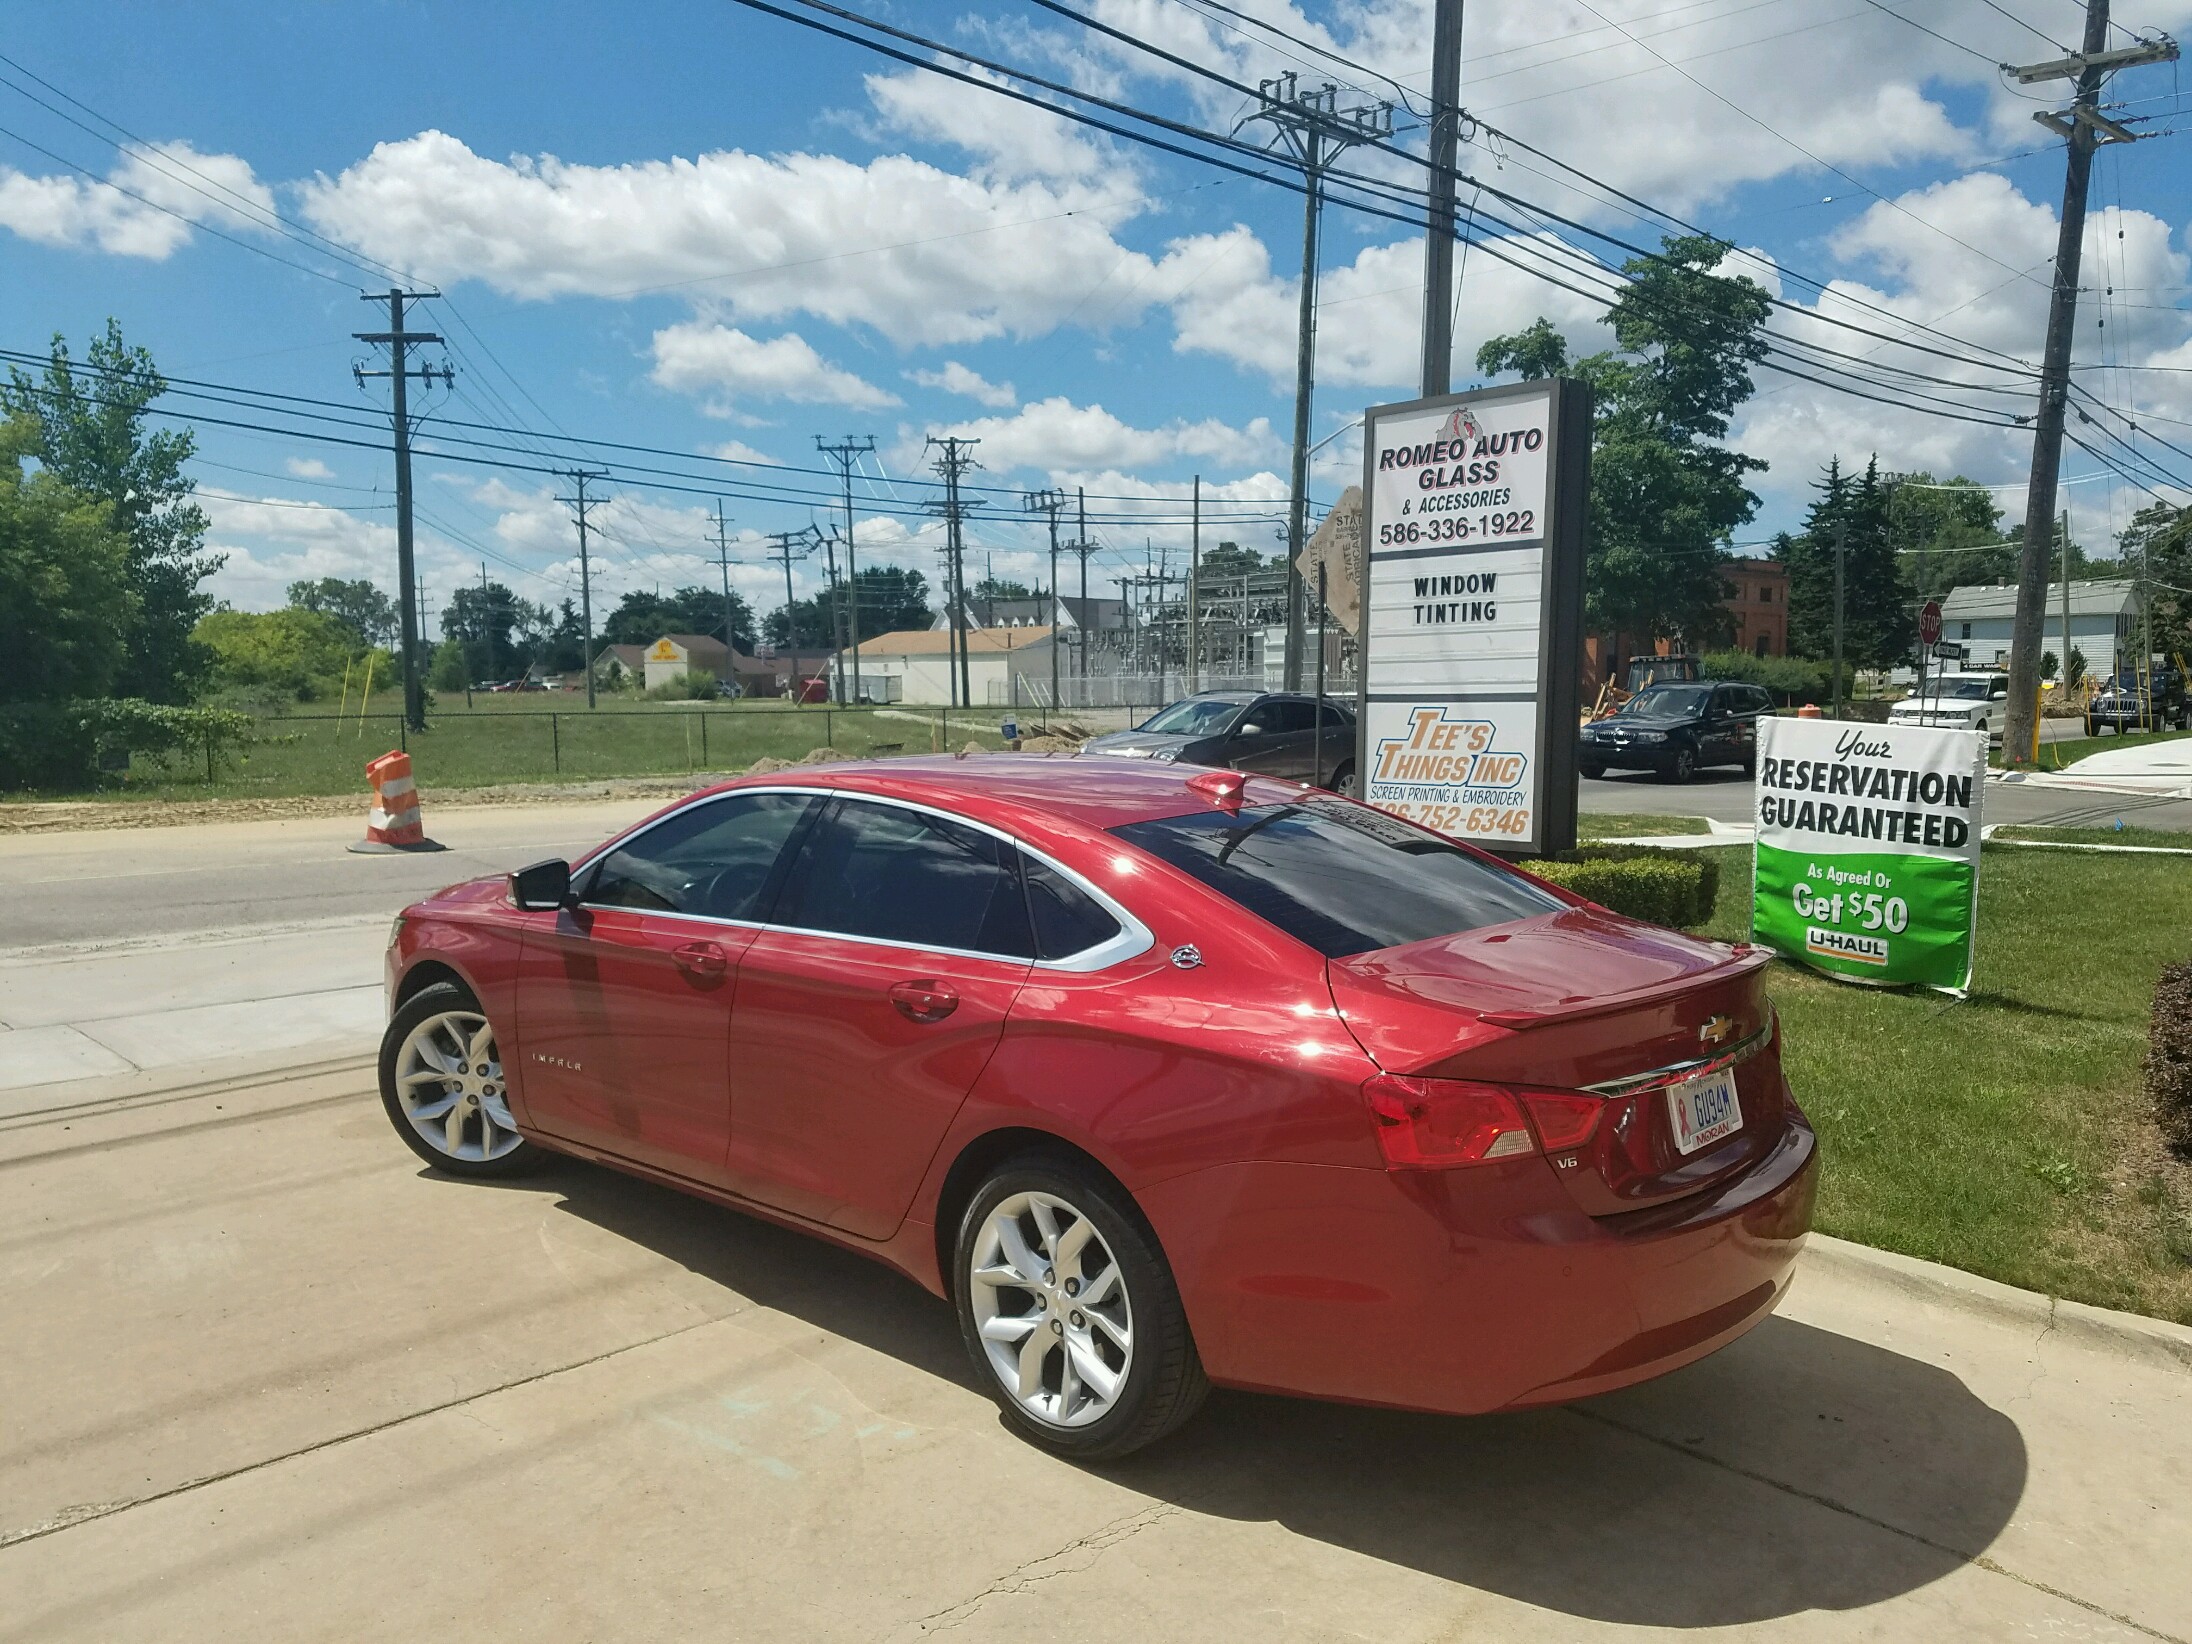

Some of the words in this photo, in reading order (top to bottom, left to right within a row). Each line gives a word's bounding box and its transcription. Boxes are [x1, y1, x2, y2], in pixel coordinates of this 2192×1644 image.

[1379, 439, 1466, 470] ROMEO
[1472, 427, 1543, 458] AUTO
[1418, 461, 1500, 491] GLASS
[1402, 498, 1411, 515] &
[1418, 487, 1511, 514] ACCESSORIES
[1379, 510, 1536, 546] 586-336-1922
[1414, 572, 1498, 598] WINDOW
[1413, 600, 1497, 624] TINTING
[1921, 614, 1940, 632] STOP
[1411, 712, 1490, 751] TEE'S
[1835, 729, 1893, 762] Your
[1379, 744, 1470, 781] THINGS
[1474, 756, 1521, 783] INC
[1370, 786, 1406, 800] SCREEN
[1407, 787, 1450, 803] PRINTING
[1453, 789, 1459, 803] &
[1463, 790, 1527, 806] EMBROIDERY
[1762, 757, 1973, 808] RESERVATION
[1372, 802, 1529, 835] 6-752-6346
[1761, 795, 1969, 848] GUARANTEED
[1807, 862, 1823, 879] As
[1826, 864, 1871, 887] Agreed
[1875, 872, 1891, 889] Or
[1792, 883, 1844, 925] Get
[1848, 890, 1909, 934] $50
[1810, 930, 1885, 956] U-HAUL
[532, 1053, 582, 1071] IMPALA
[1696, 1121, 1730, 1146] MORAN
[1556, 1157, 1578, 1169] V6
